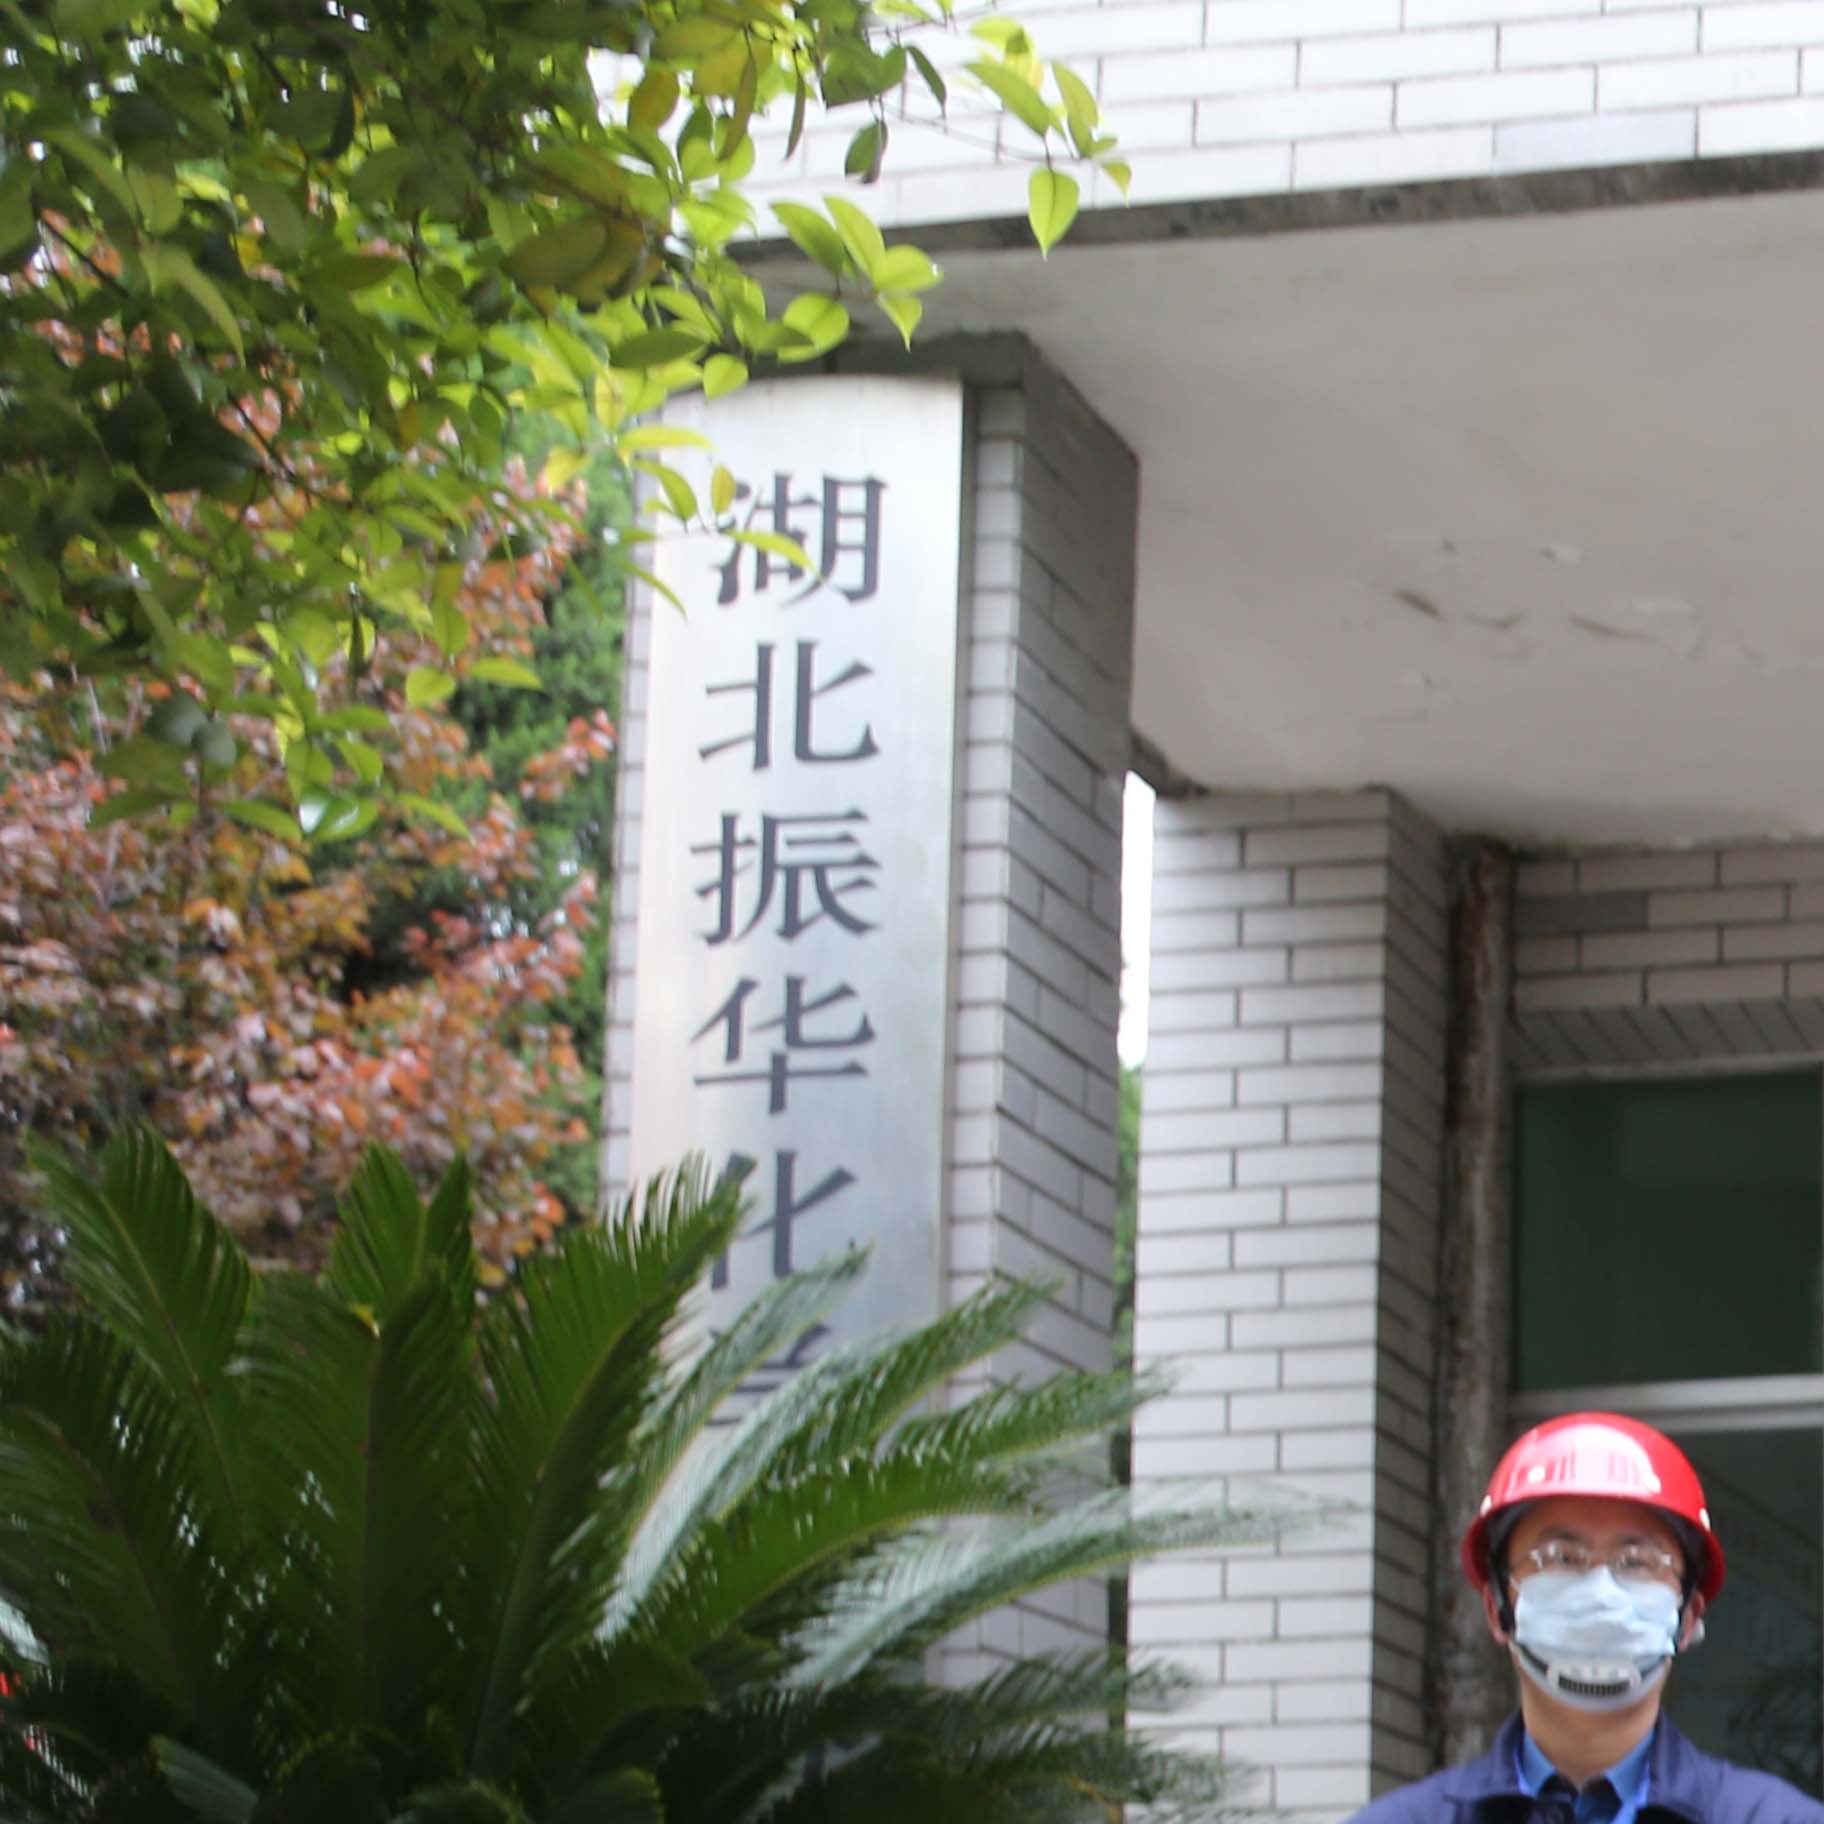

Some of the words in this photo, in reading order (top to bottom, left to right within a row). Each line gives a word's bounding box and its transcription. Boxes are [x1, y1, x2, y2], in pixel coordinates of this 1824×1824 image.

[687, 472, 890, 1425] 湖北振华化
